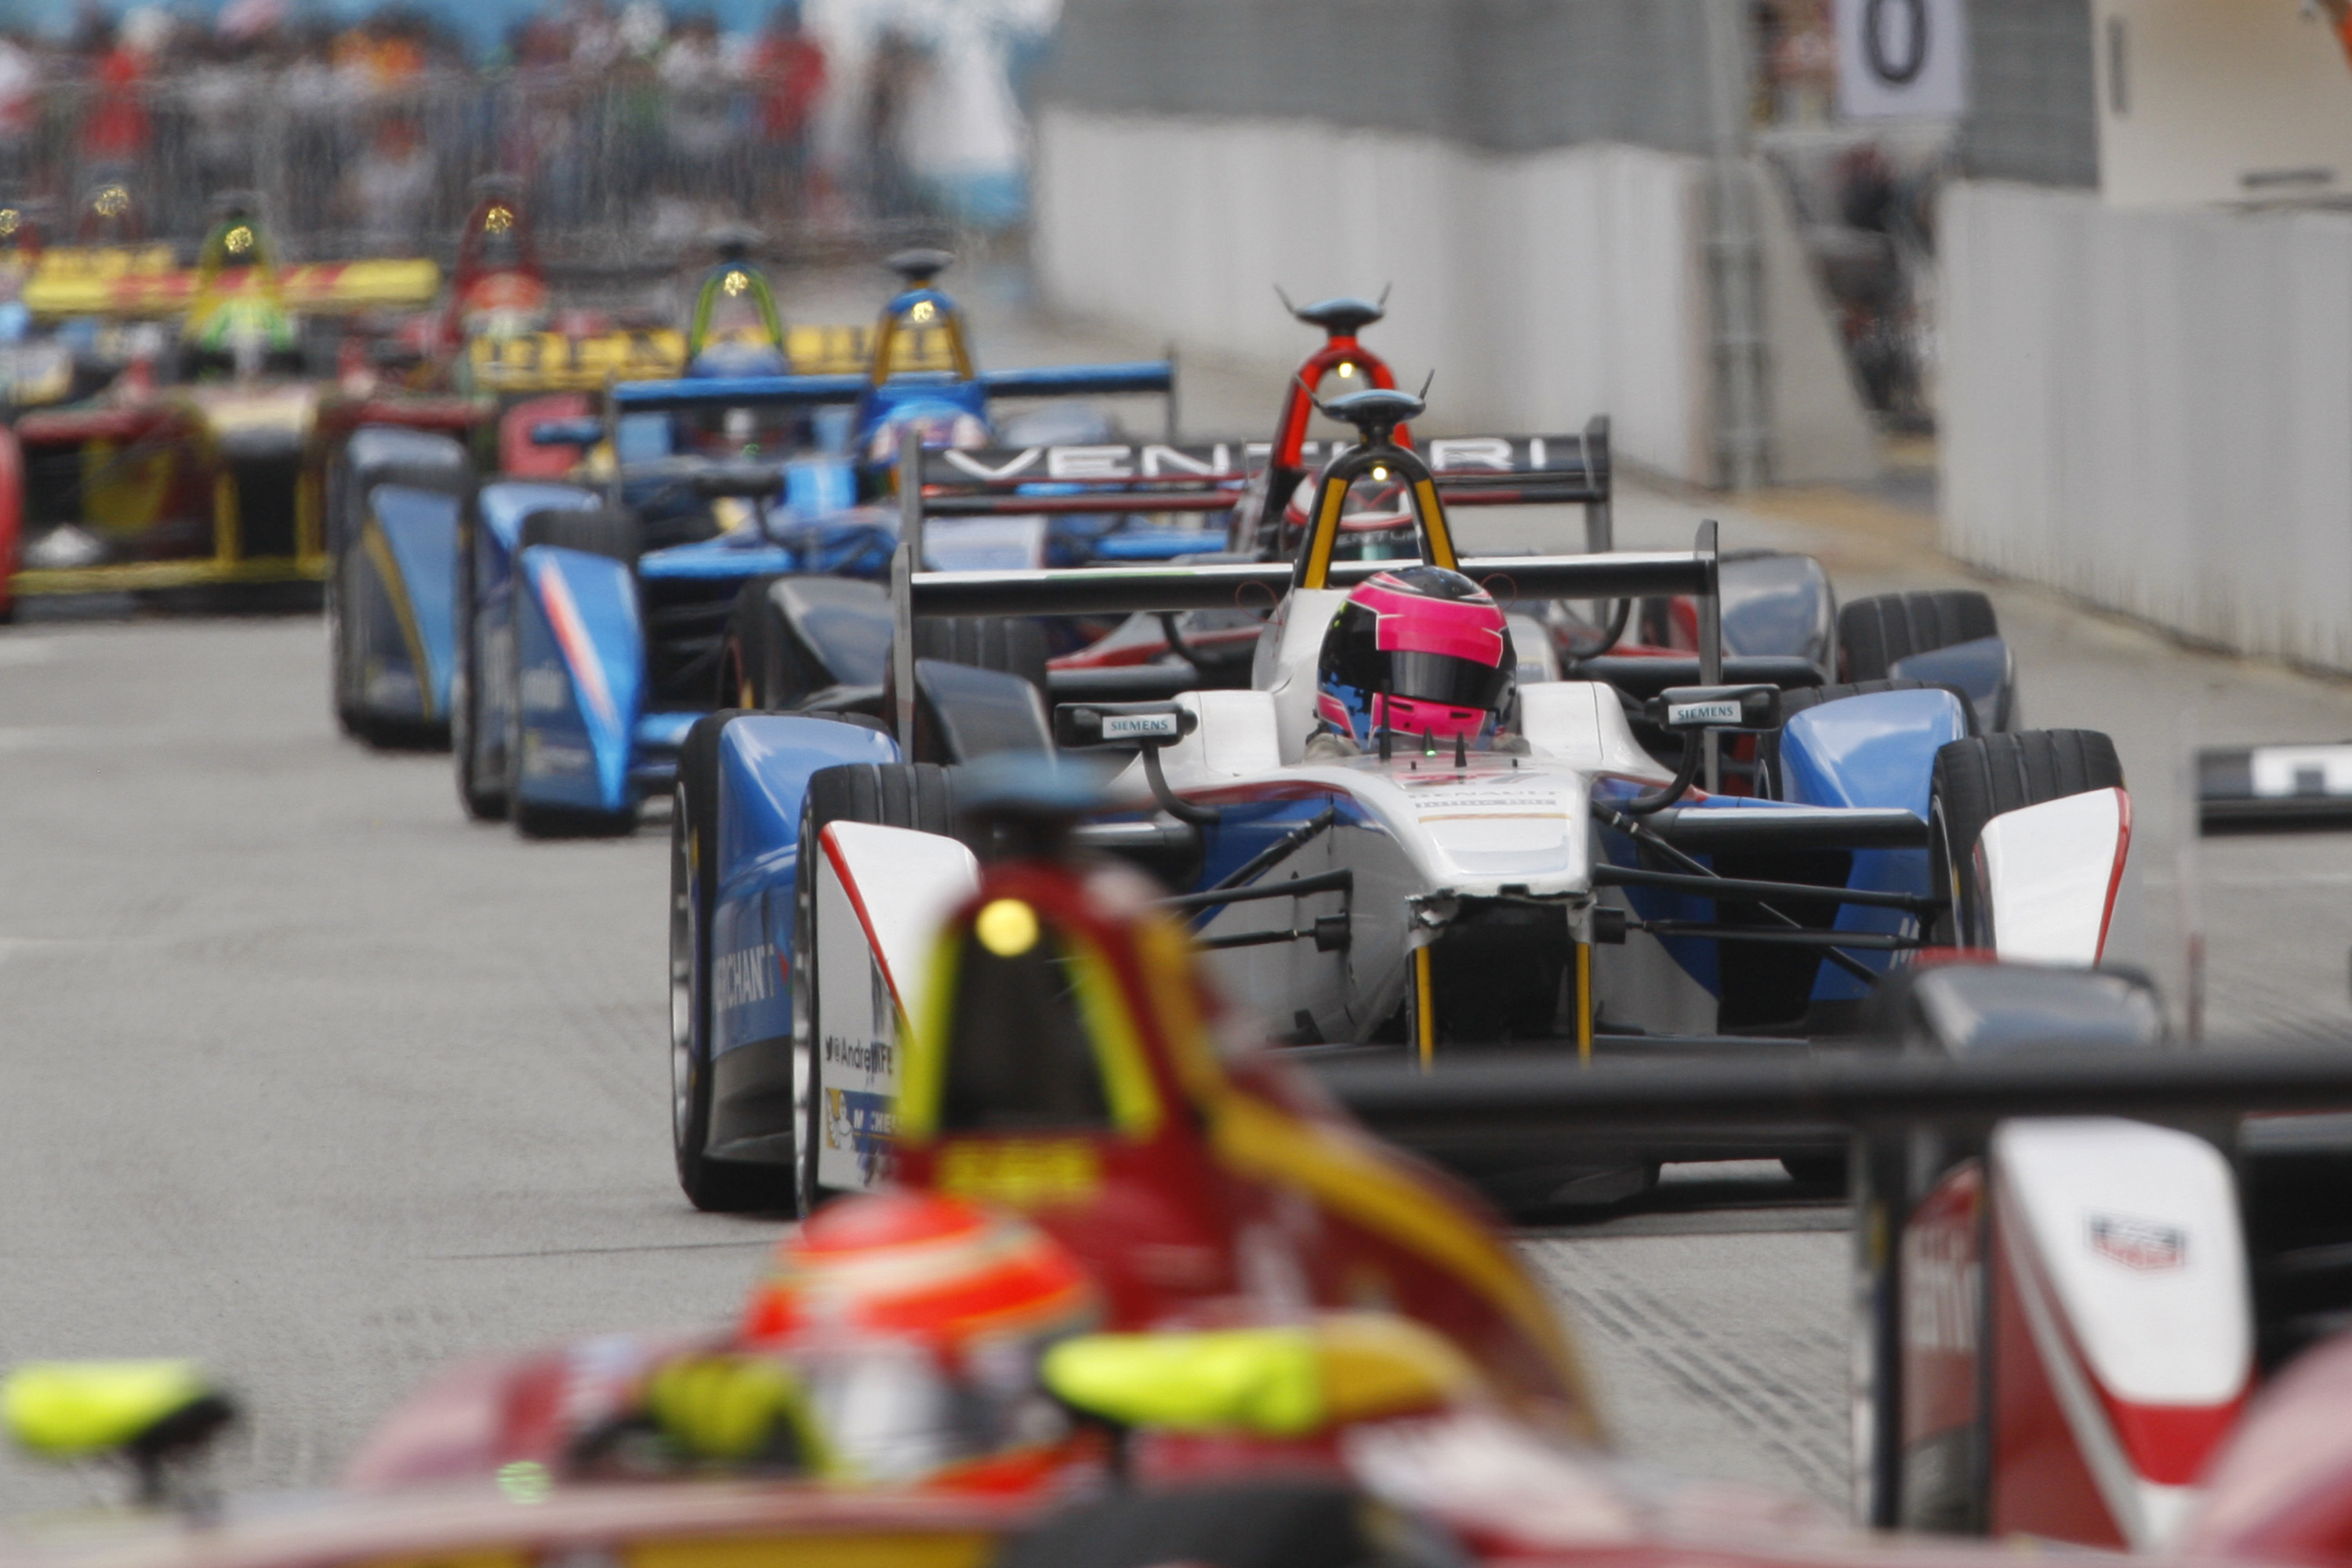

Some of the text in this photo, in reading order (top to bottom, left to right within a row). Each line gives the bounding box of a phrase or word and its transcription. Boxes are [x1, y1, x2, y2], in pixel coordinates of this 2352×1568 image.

[944, 438, 1545, 481] VENRI
[1678, 706, 1733, 720] SIEMENS
[1110, 720, 1168, 731] SIEMENS
